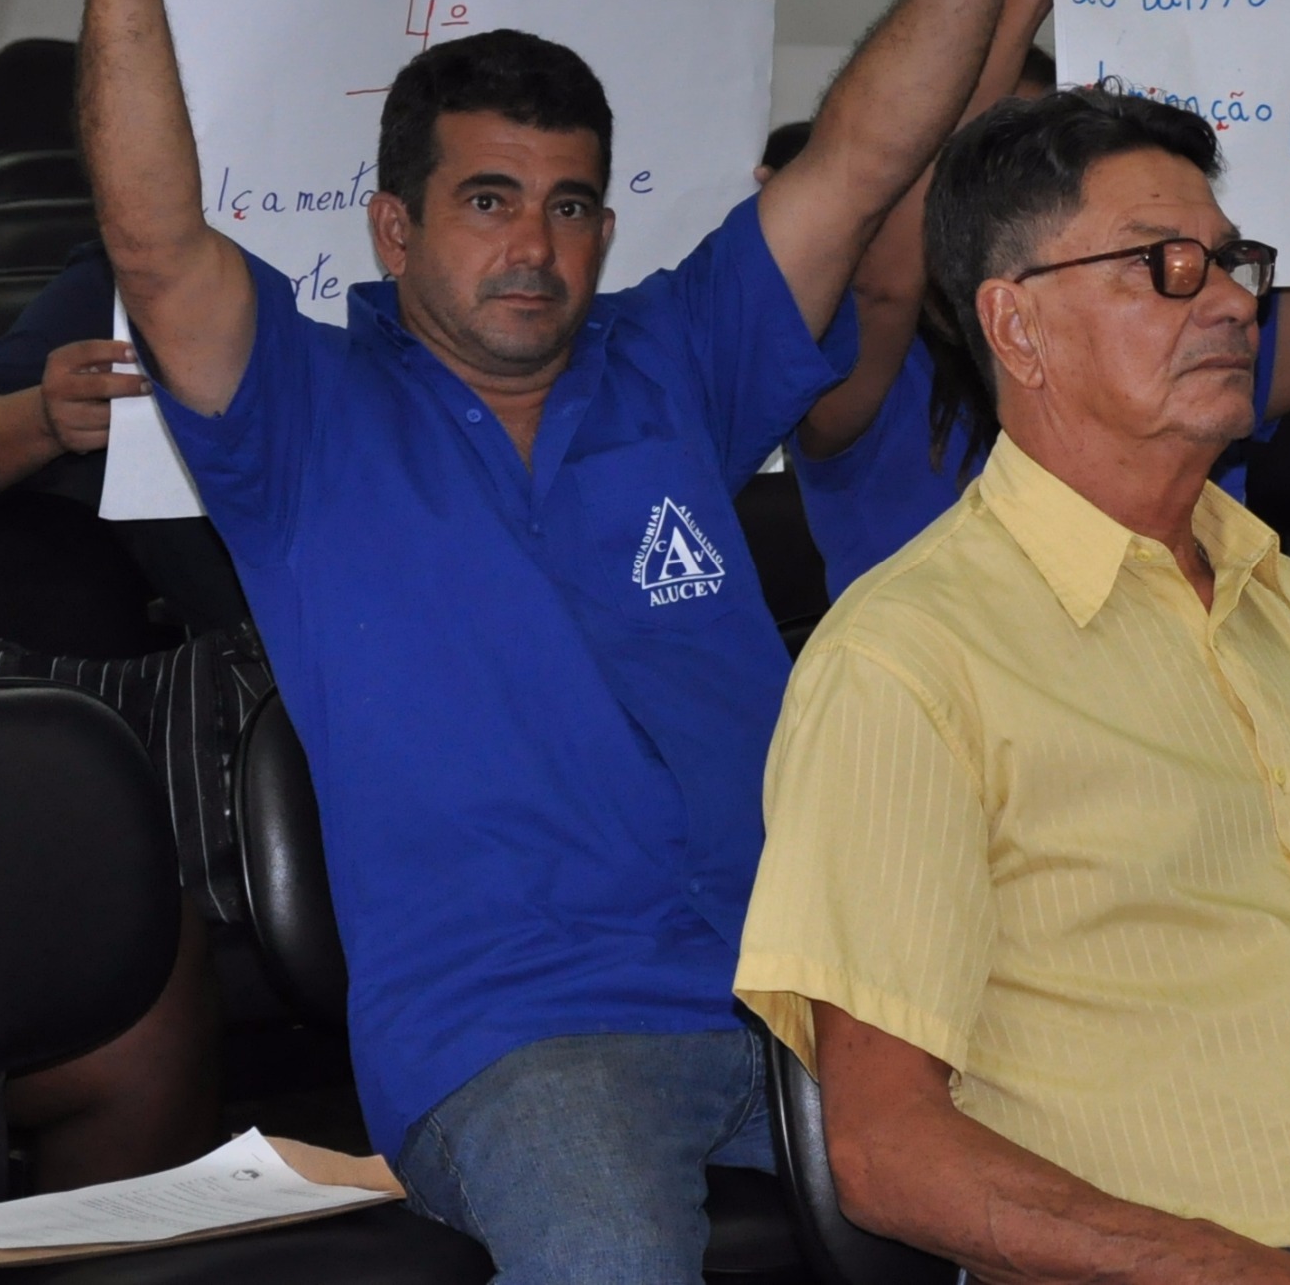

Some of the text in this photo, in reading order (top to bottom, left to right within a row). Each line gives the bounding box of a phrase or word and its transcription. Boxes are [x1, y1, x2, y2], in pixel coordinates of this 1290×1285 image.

[630, 171, 653, 193] e
[631, 505, 662, 584] ESQUADRIAS
[650, 579, 723, 607] ALUCEV
